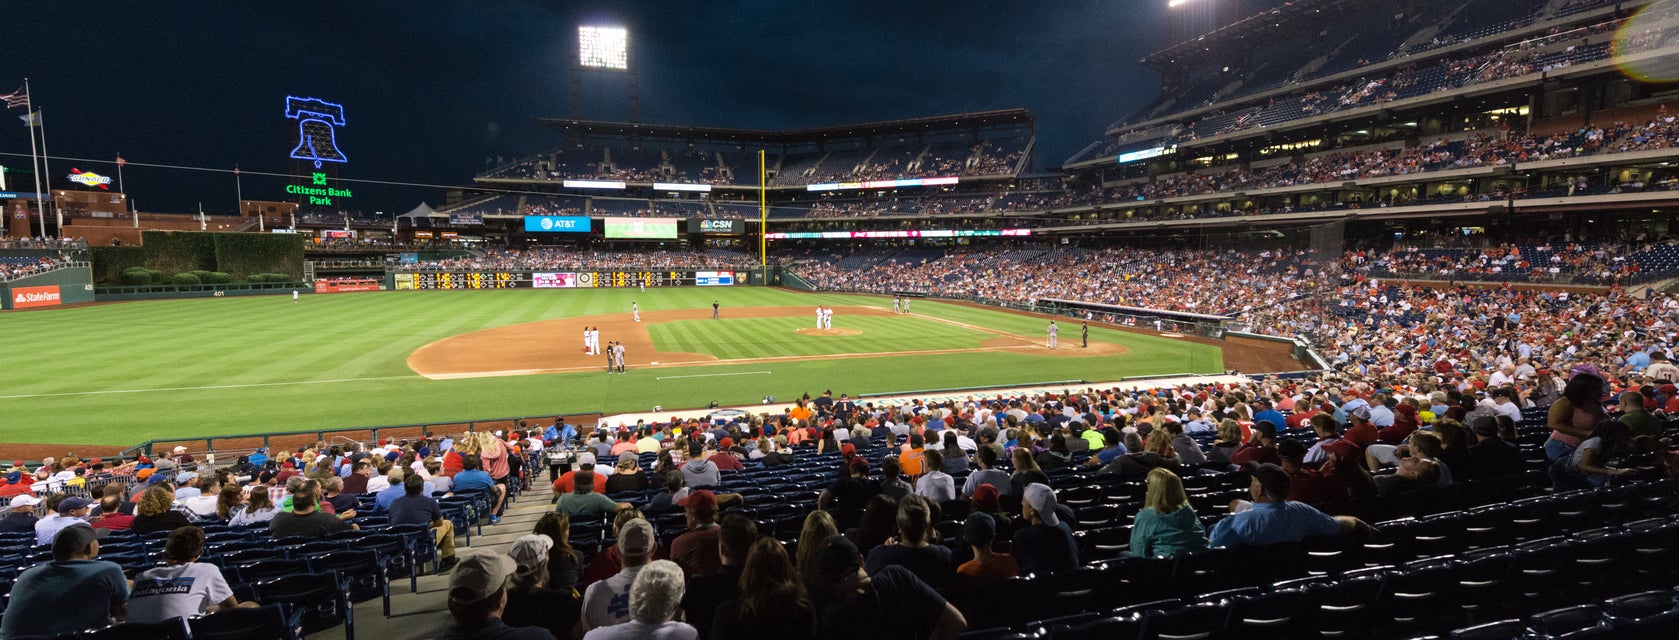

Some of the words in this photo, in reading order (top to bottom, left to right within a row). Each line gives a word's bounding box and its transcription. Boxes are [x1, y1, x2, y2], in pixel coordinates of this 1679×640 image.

[73, 175, 109, 183] SUNOCO
[286, 184, 327, 196] Citizens
[328, 187, 352, 198] Bank
[309, 196, 332, 206] Park
[554, 220, 576, 228] AT&T
[712, 220, 733, 228] CSN
